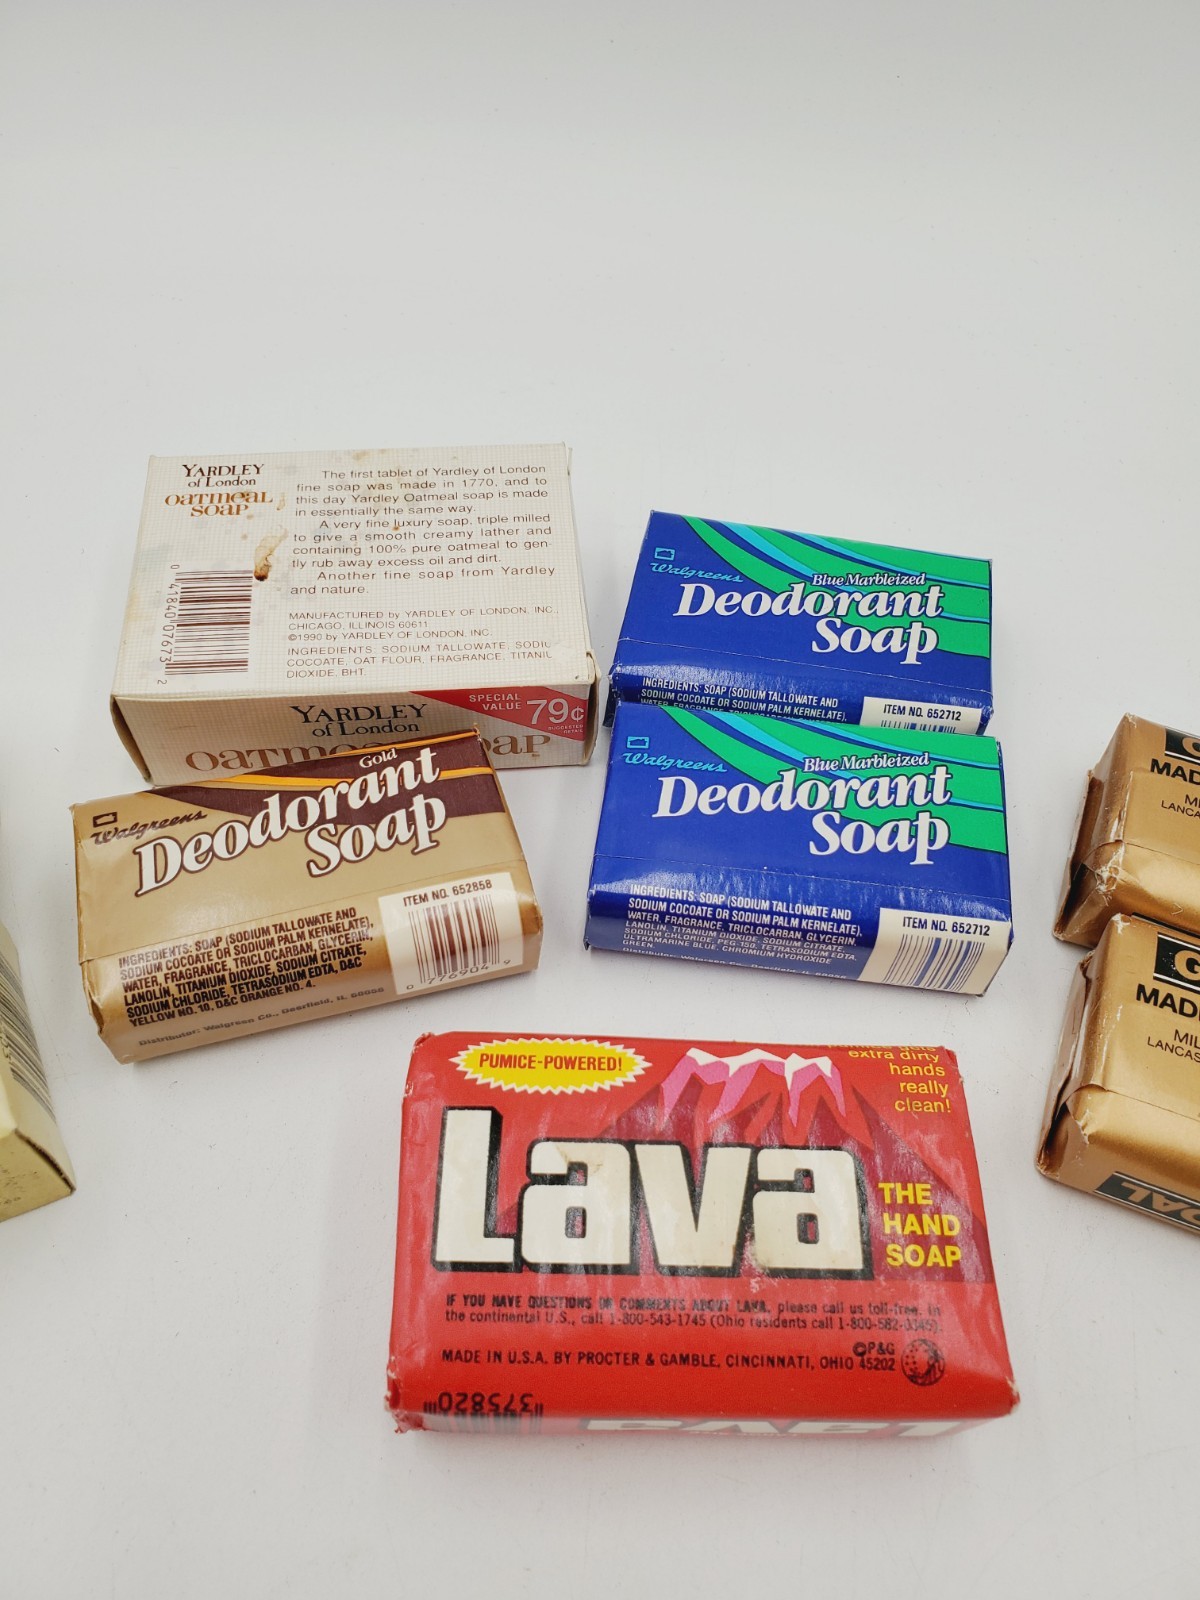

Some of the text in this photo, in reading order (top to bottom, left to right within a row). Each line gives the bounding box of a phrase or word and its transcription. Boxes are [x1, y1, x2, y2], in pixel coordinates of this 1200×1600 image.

[182, 464, 264, 477] YARDLEY
[321, 465, 545, 479] The first tablet of Yardley of London
[188, 476, 256, 487] of London
[296, 483, 320, 491] fine
[328, 484, 360, 492] soap
[400, 481, 436, 489] made
[443, 480, 454, 488] in
[295, 490, 548, 505] this day Yardley Oatmeal soap is made
[295, 508, 306, 516] in
[310, 507, 381, 518] essentially
[383, 506, 403, 514] the
[447, 506, 475, 514] way.
[319, 521, 328, 529] A
[333, 522, 360, 530] very
[366, 519, 389, 527] fine
[394, 518, 432, 528] luxury
[477, 516, 508, 526] triple
[513, 514, 550, 523] milled
[293, 534, 306, 542] to
[313, 533, 342, 543] give
[364, 531, 415, 540] smooth
[423, 531, 473, 540] creamy
[480, 528, 519, 536] lather
[526, 527, 551, 535] and
[292, 545, 361, 556] containing
[369, 544, 406, 552] 100%
[412, 544, 441, 553] pure
[447, 541, 499, 550] oatmeal
[505, 541, 517, 549] to
[292, 559, 306, 569] tly
[312, 558, 333, 567] rub
[338, 559, 372, 568] away
[428, 556, 443, 564] oil
[448, 555, 472, 563] and
[477, 554, 500, 563] dirt.
[316, 566, 555, 580] Another fine soap from Yardley
[650, 562, 744, 583] Walgreens
[812, 573, 926, 586] Blue Marbleized
[290, 585, 368, 594] and nature.
[673, 583, 944, 617] Deodorant
[288, 610, 383, 620] MANUFACTURED
[388, 610, 399, 620] by
[404, 608, 455, 617] YARDLEY
[459, 608, 474, 616] OF
[348, 621, 395, 629] ILLINOIS
[325, 633, 338, 642] by
[341, 631, 394, 640] YARDLEY
[396, 631, 412, 639] OF
[812, 618, 938, 664] Soap
[469, 694, 520, 702] SPECIAL
[482, 702, 520, 710] VALUE
[290, 704, 428, 724] YARDLEY
[883, 704, 961, 721] ITEM NO. 652712
[312, 720, 419, 737] of London
[360, 748, 398, 768] Gold
[621, 752, 727, 772] Walgreens
[803, 753, 930, 772] Blue Marbleized
[652, 766, 952, 818] Deodorant
[91, 809, 207, 844] Walgreens
[136, 748, 440, 896] Deodorant
[308, 793, 446, 876] Soap
[809, 811, 949, 865] Soap
[403, 880, 492, 907] ITEM NO. 652858
[699, 892, 725, 906] SOAP
[727, 895, 768, 912] (SODIUM
[772, 900, 827, 917] TALLOWATE
[831, 907, 851, 920] AND
[903, 916, 990, 936] ITEM NO. 652712
[123, 944, 367, 1007] LANOLIN, TITANIUM DIOXIDE, SODIUM CITRATE,
[479, 1052, 624, 1072] PUMICE-POWERED!
[848, 1050, 938, 1062] extra dirty
[889, 1062, 945, 1076] hands
[900, 1080, 948, 1098] really
[895, 1098, 951, 1112] clean!
[433, 1106, 873, 1279] Lava
[878, 1182, 932, 1204] THE
[883, 1214, 960, 1236] HAND
[886, 1244, 961, 1268] SOAP
[441, 1350, 480, 1362] MADE
[487, 1351, 502, 1362] IN
[507, 1351, 548, 1364] U.S.A.
[553, 1352, 571, 1364] BY
[577, 1352, 639, 1365] PROCTER
[645, 1354, 654, 1366] &
[819, 1356, 853, 1370] OHIO
[859, 1357, 896, 1370] 45202
